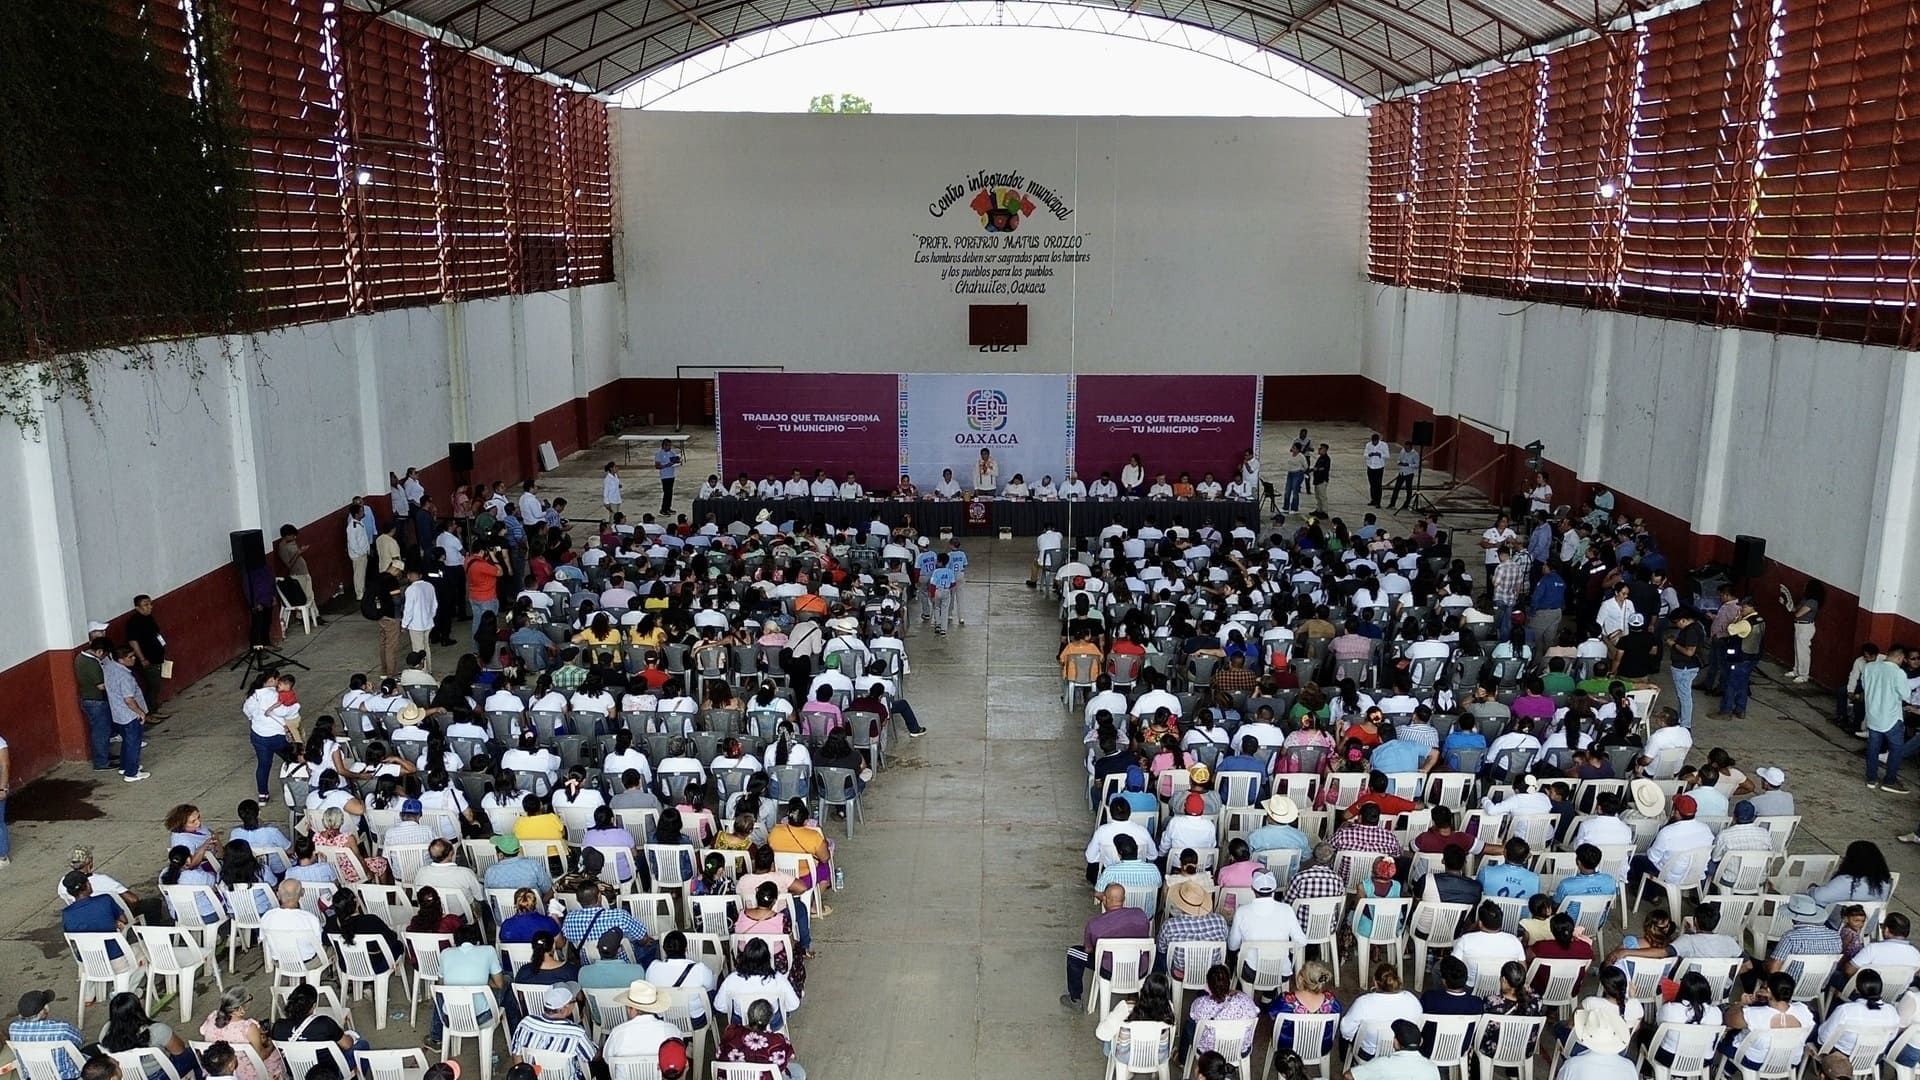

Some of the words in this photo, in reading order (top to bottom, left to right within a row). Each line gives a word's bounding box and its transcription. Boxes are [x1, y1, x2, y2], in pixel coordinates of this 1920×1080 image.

[929, 184, 965, 217] Centro
[966, 169, 1025, 193] integrador
[1026, 180, 1074, 221] municipal
[1002, 235, 1039, 249] MATUS
[914, 250, 930, 263] Los
[930, 251, 961, 263] hombres
[962, 251, 983, 263] deben
[984, 255, 997, 263] ser
[997, 251, 1032, 265] sagrados
[1032, 254, 1050, 265] para
[1051, 251, 1062, 262] los
[1062, 251, 1091, 262] hombres
[941, 268, 948, 280] y
[948, 265, 960, 277] los
[960, 265, 990, 279] pueblos
[991, 267, 1011, 279] para
[1011, 265, 1022, 277] los
[1010, 280, 1046, 293] Oaxaca
[742, 413, 789, 422] TRABAJO
[791, 414, 811, 423] QUE
[814, 414, 881, 423] TRANSFORMA
[1096, 415, 1143, 423] TRABAJO
[1145, 415, 1166, 424] QUE
[1168, 415, 1236, 423] TRANSFORMA
[778, 424, 791, 432] TU
[793, 424, 845, 432] MUNICIPIO
[1131, 425, 1145, 433] TU
[1146, 425, 1199, 433] MUNICIPIO
[955, 433, 1019, 444] OAXACA
